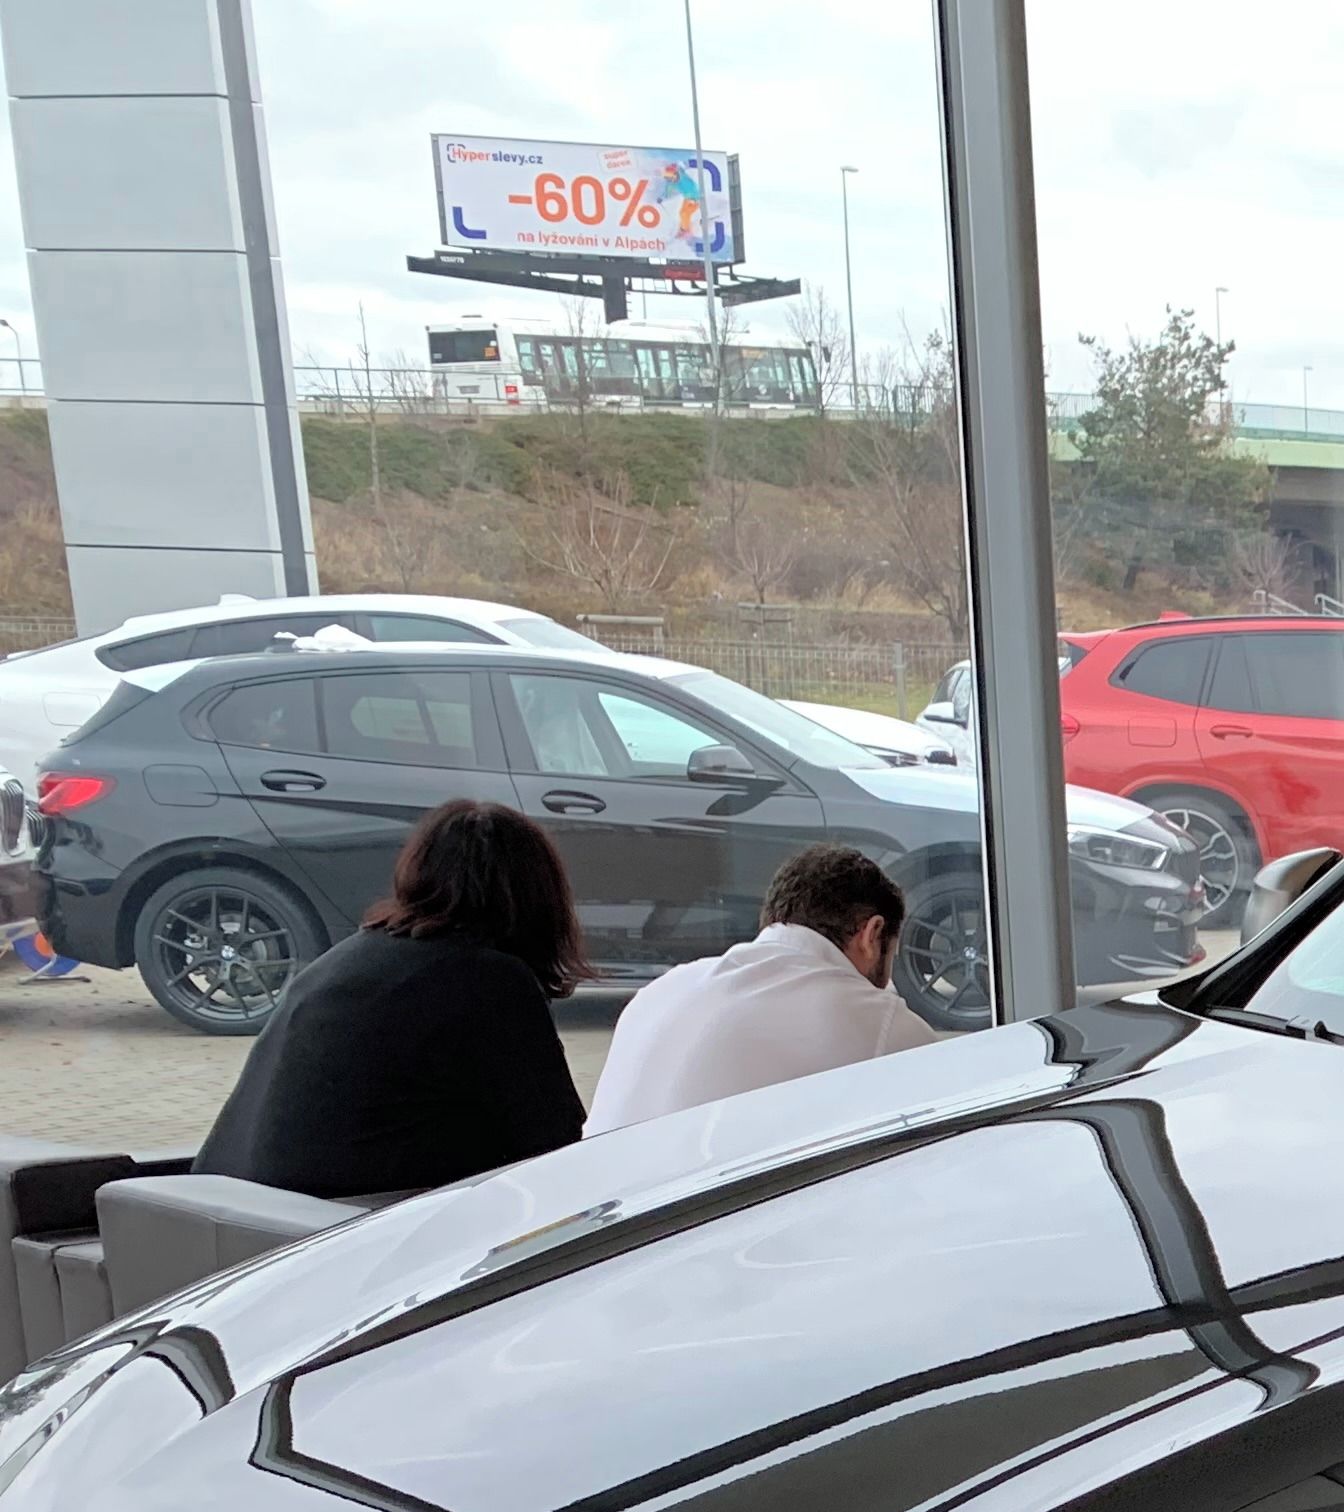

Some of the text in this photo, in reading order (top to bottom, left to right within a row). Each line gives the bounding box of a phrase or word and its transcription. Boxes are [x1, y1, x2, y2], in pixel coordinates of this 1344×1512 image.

[508, 172, 661, 229] -60%
[517, 231, 535, 243] na
[602, 237, 610, 247] v
